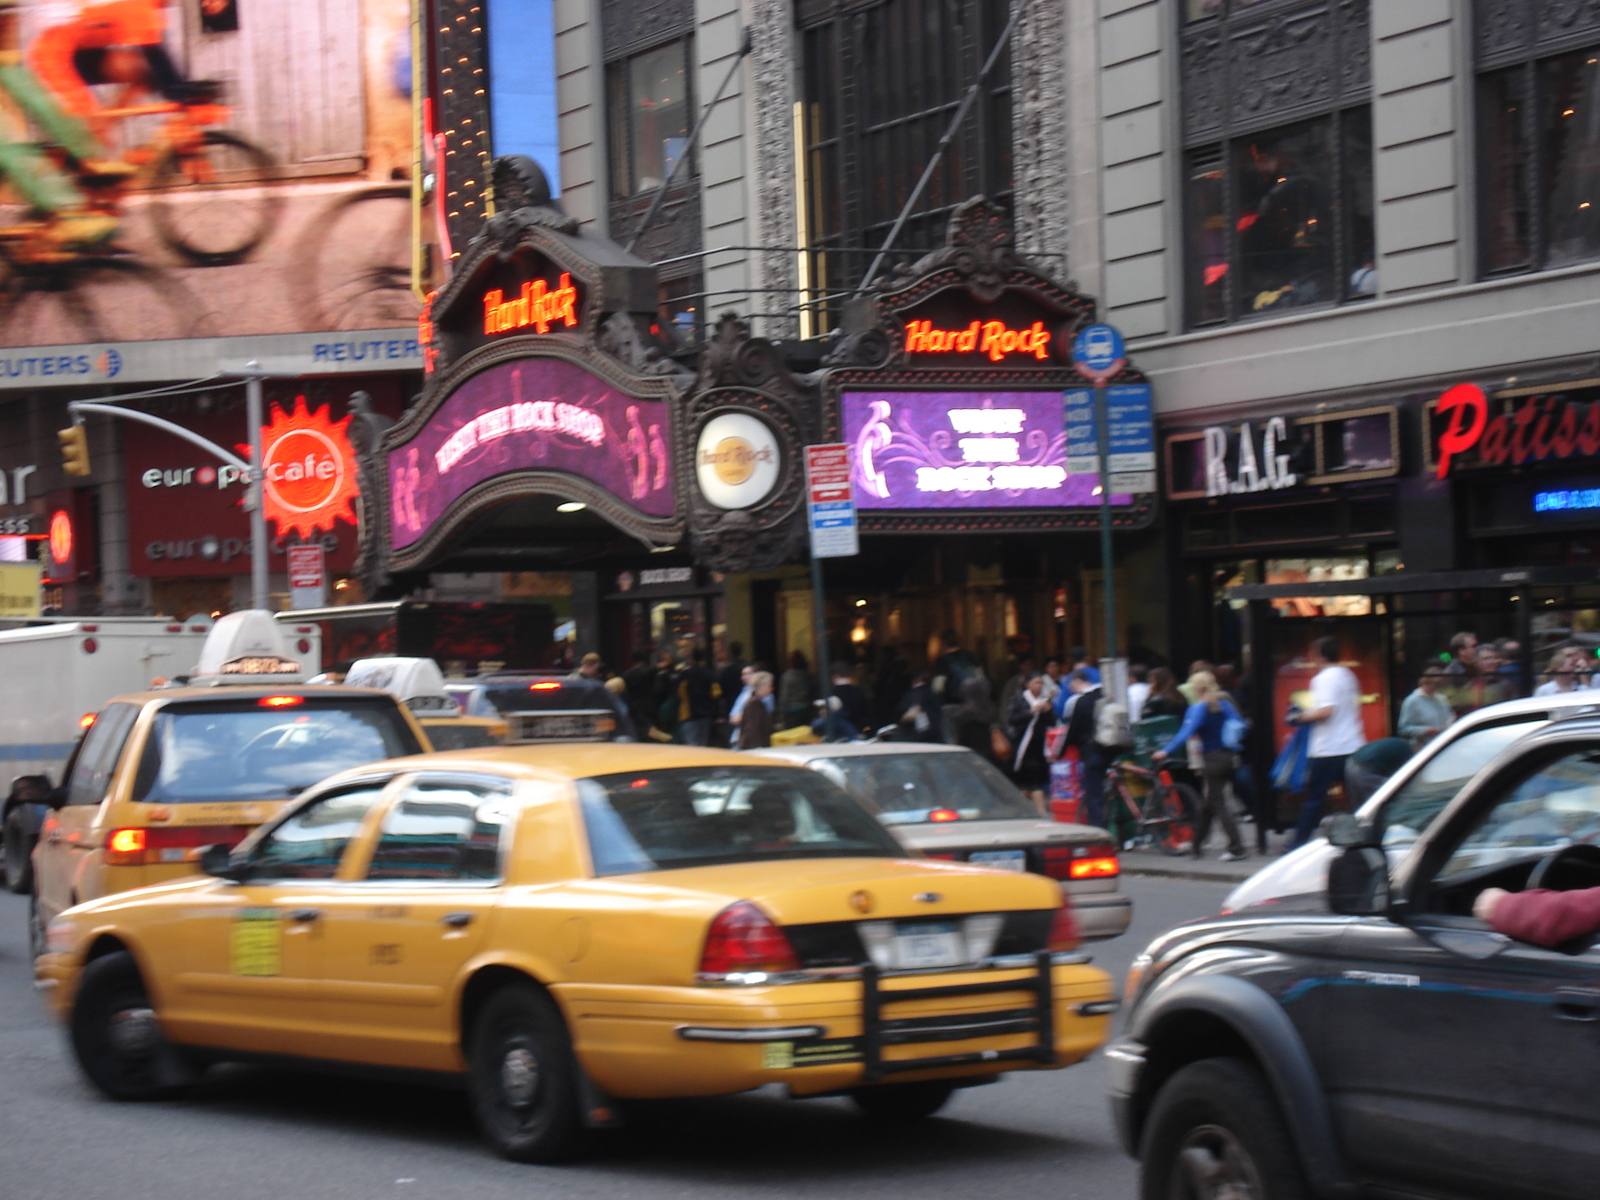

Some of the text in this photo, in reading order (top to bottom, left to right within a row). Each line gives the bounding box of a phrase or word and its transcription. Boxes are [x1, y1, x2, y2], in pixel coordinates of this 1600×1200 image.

[313, 339, 423, 362] REUTER
[905, 318, 1051, 361] Hard Rock
